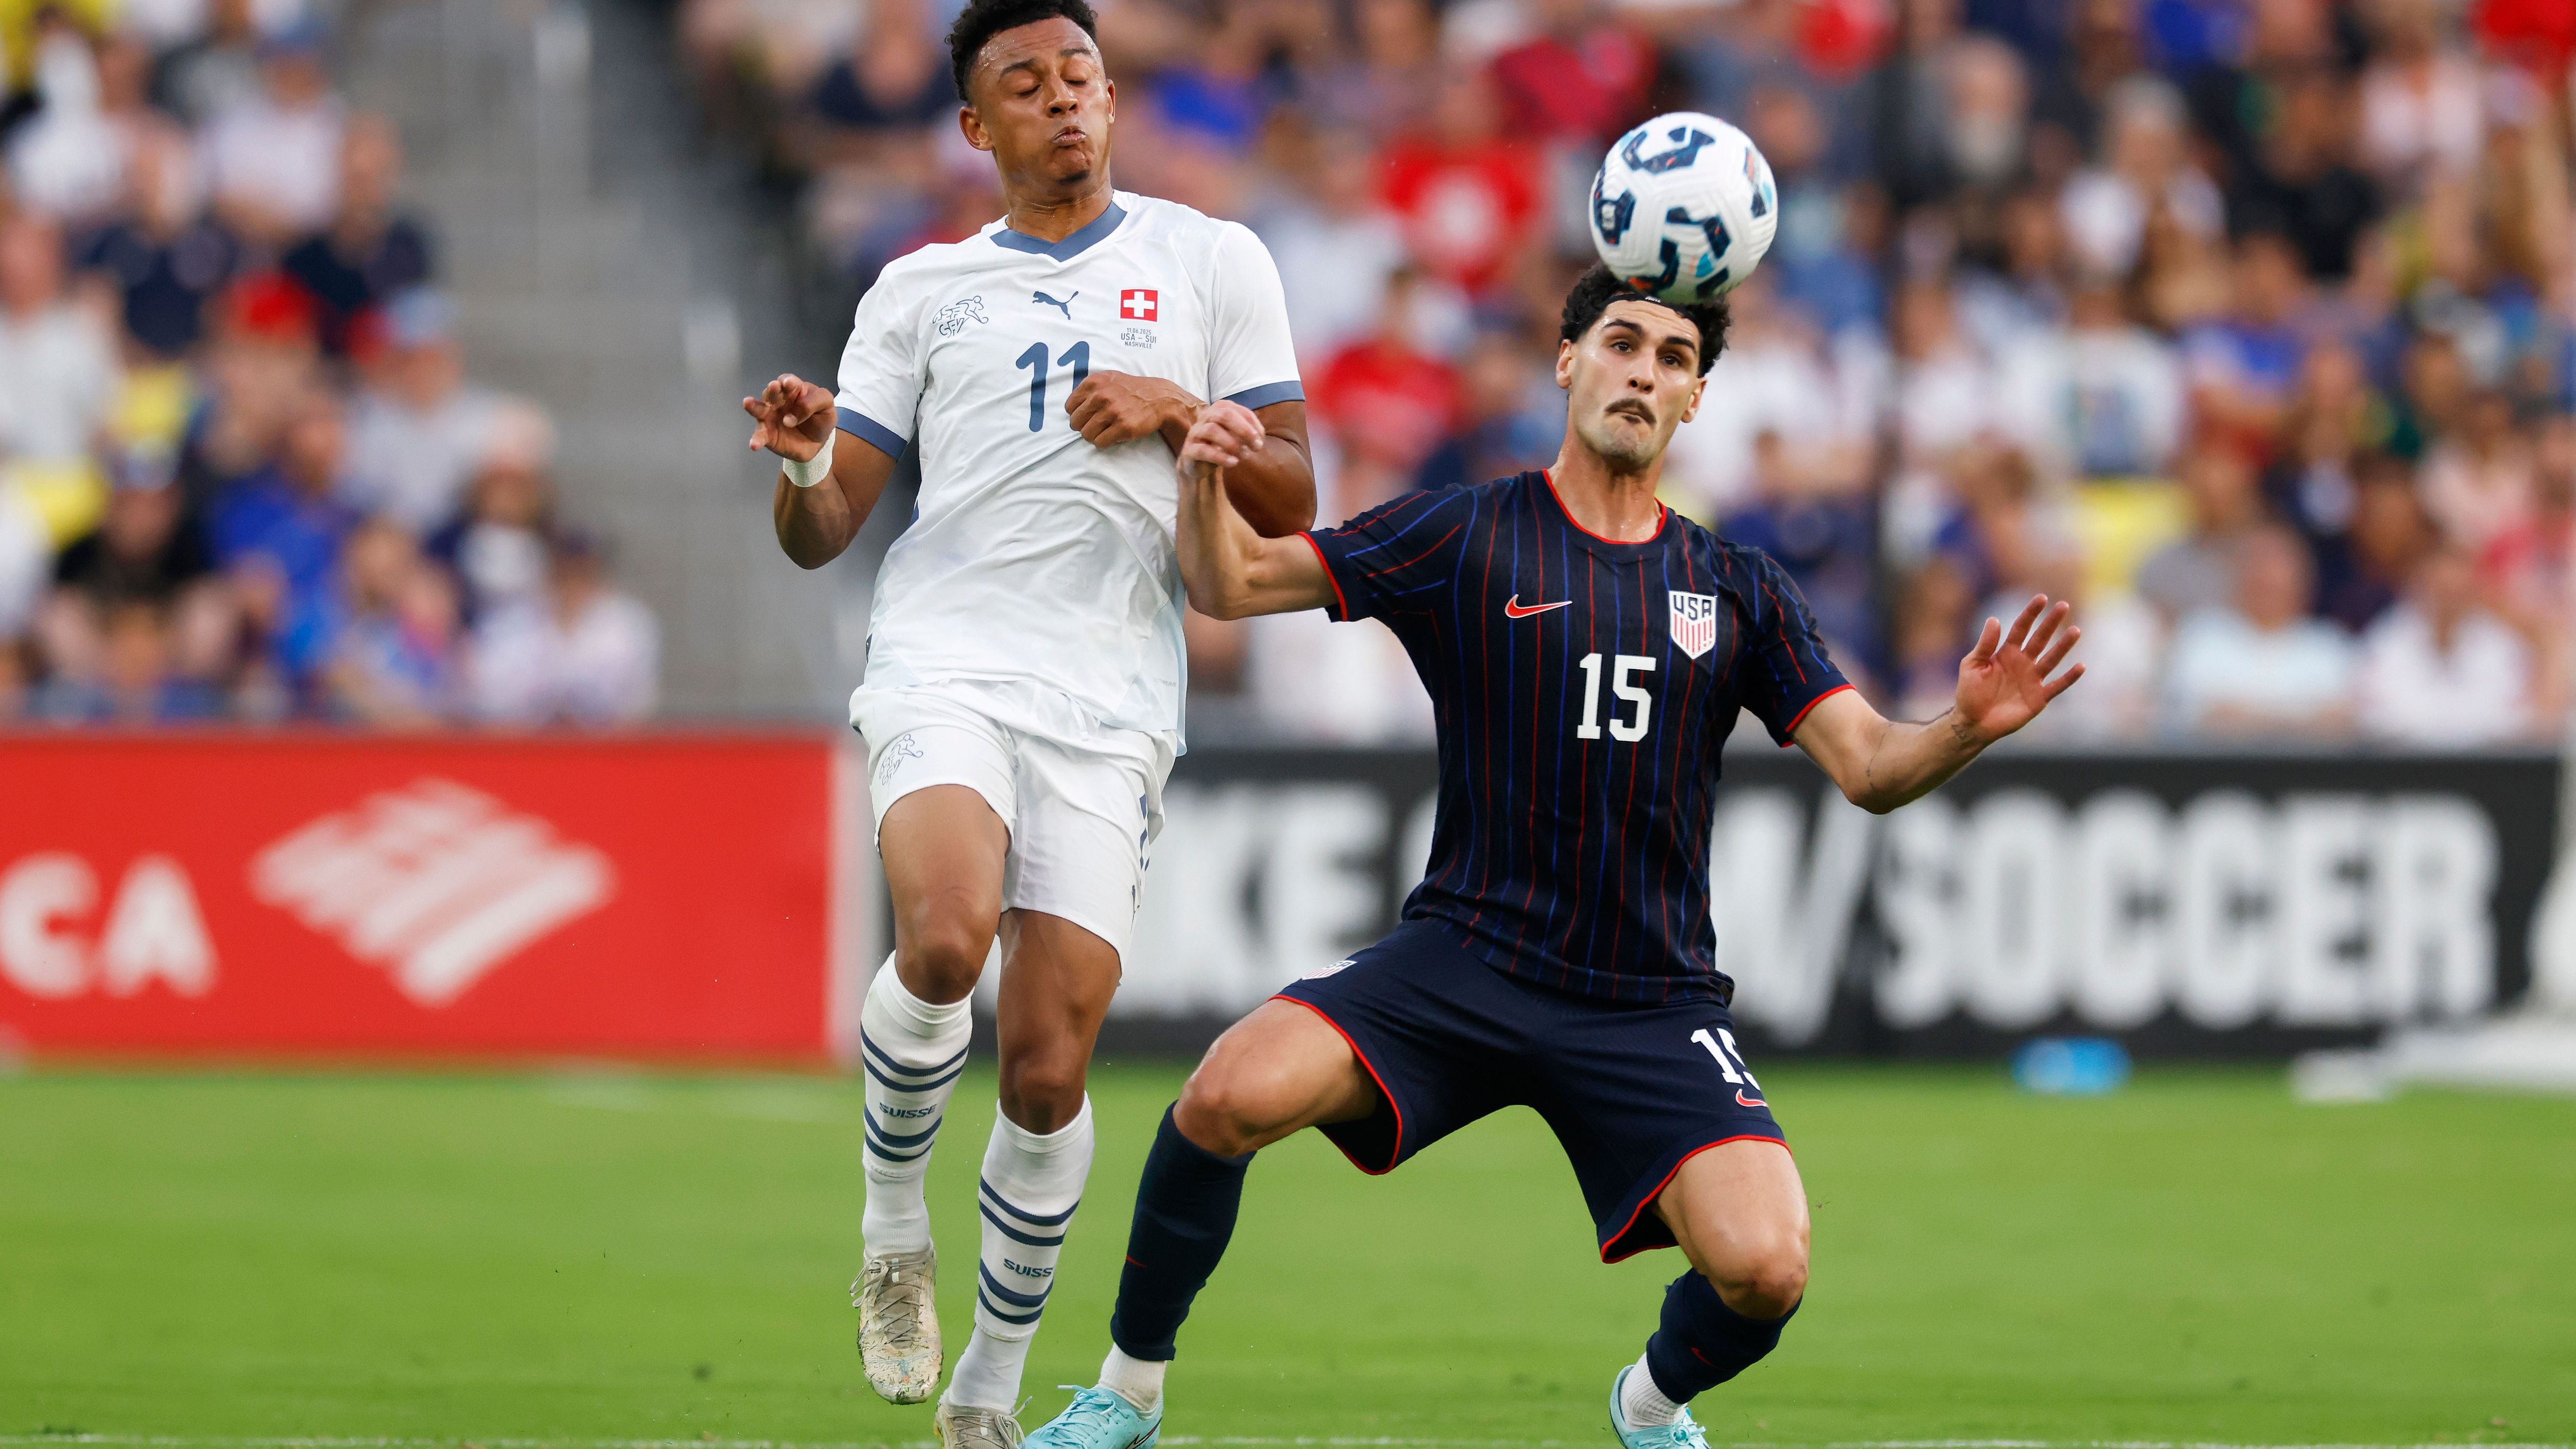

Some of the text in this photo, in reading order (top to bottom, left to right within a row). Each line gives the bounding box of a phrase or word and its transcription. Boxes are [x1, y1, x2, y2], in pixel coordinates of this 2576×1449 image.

[1121, 333, 1136, 341] USA
[1145, 335, 1157, 344] SUI
[1124, 341, 1152, 349] NASHVILLE
[1016, 342, 1089, 432] 11
[1673, 595, 1712, 621] USA
[1577, 653, 1657, 742] 15
[879, 1102, 937, 1119] SUISSE
